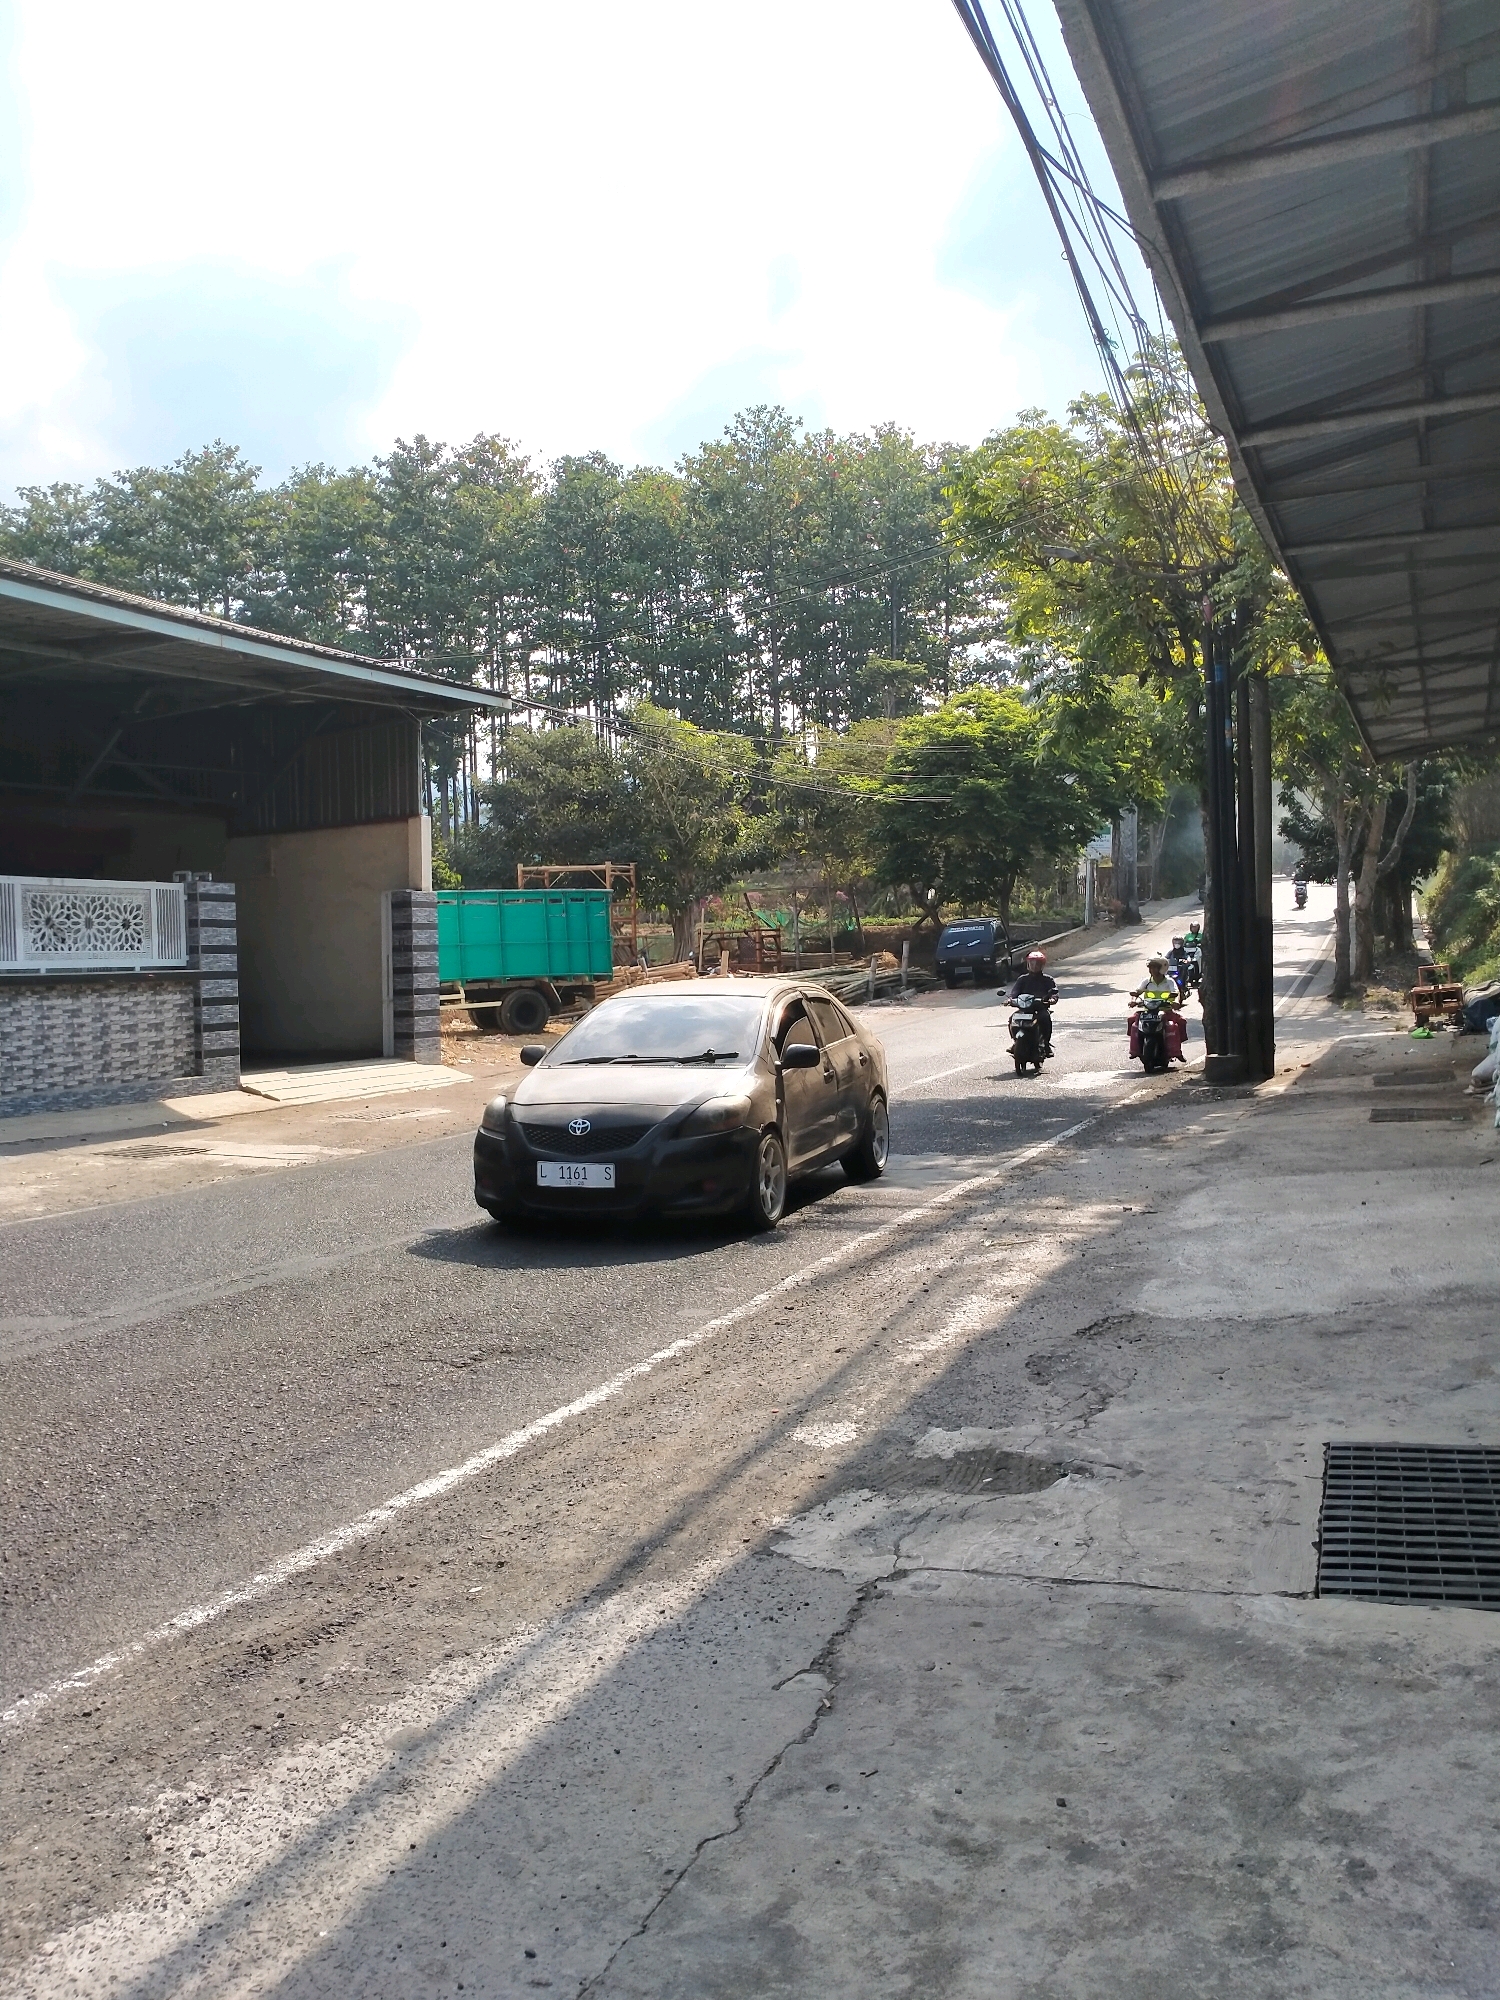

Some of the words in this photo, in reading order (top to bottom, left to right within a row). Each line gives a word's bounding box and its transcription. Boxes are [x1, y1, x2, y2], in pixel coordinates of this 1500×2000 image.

[540, 1164, 547, 1178] L
[558, 1165, 588, 1180] 1161
[604, 1166, 612, 1181] S
